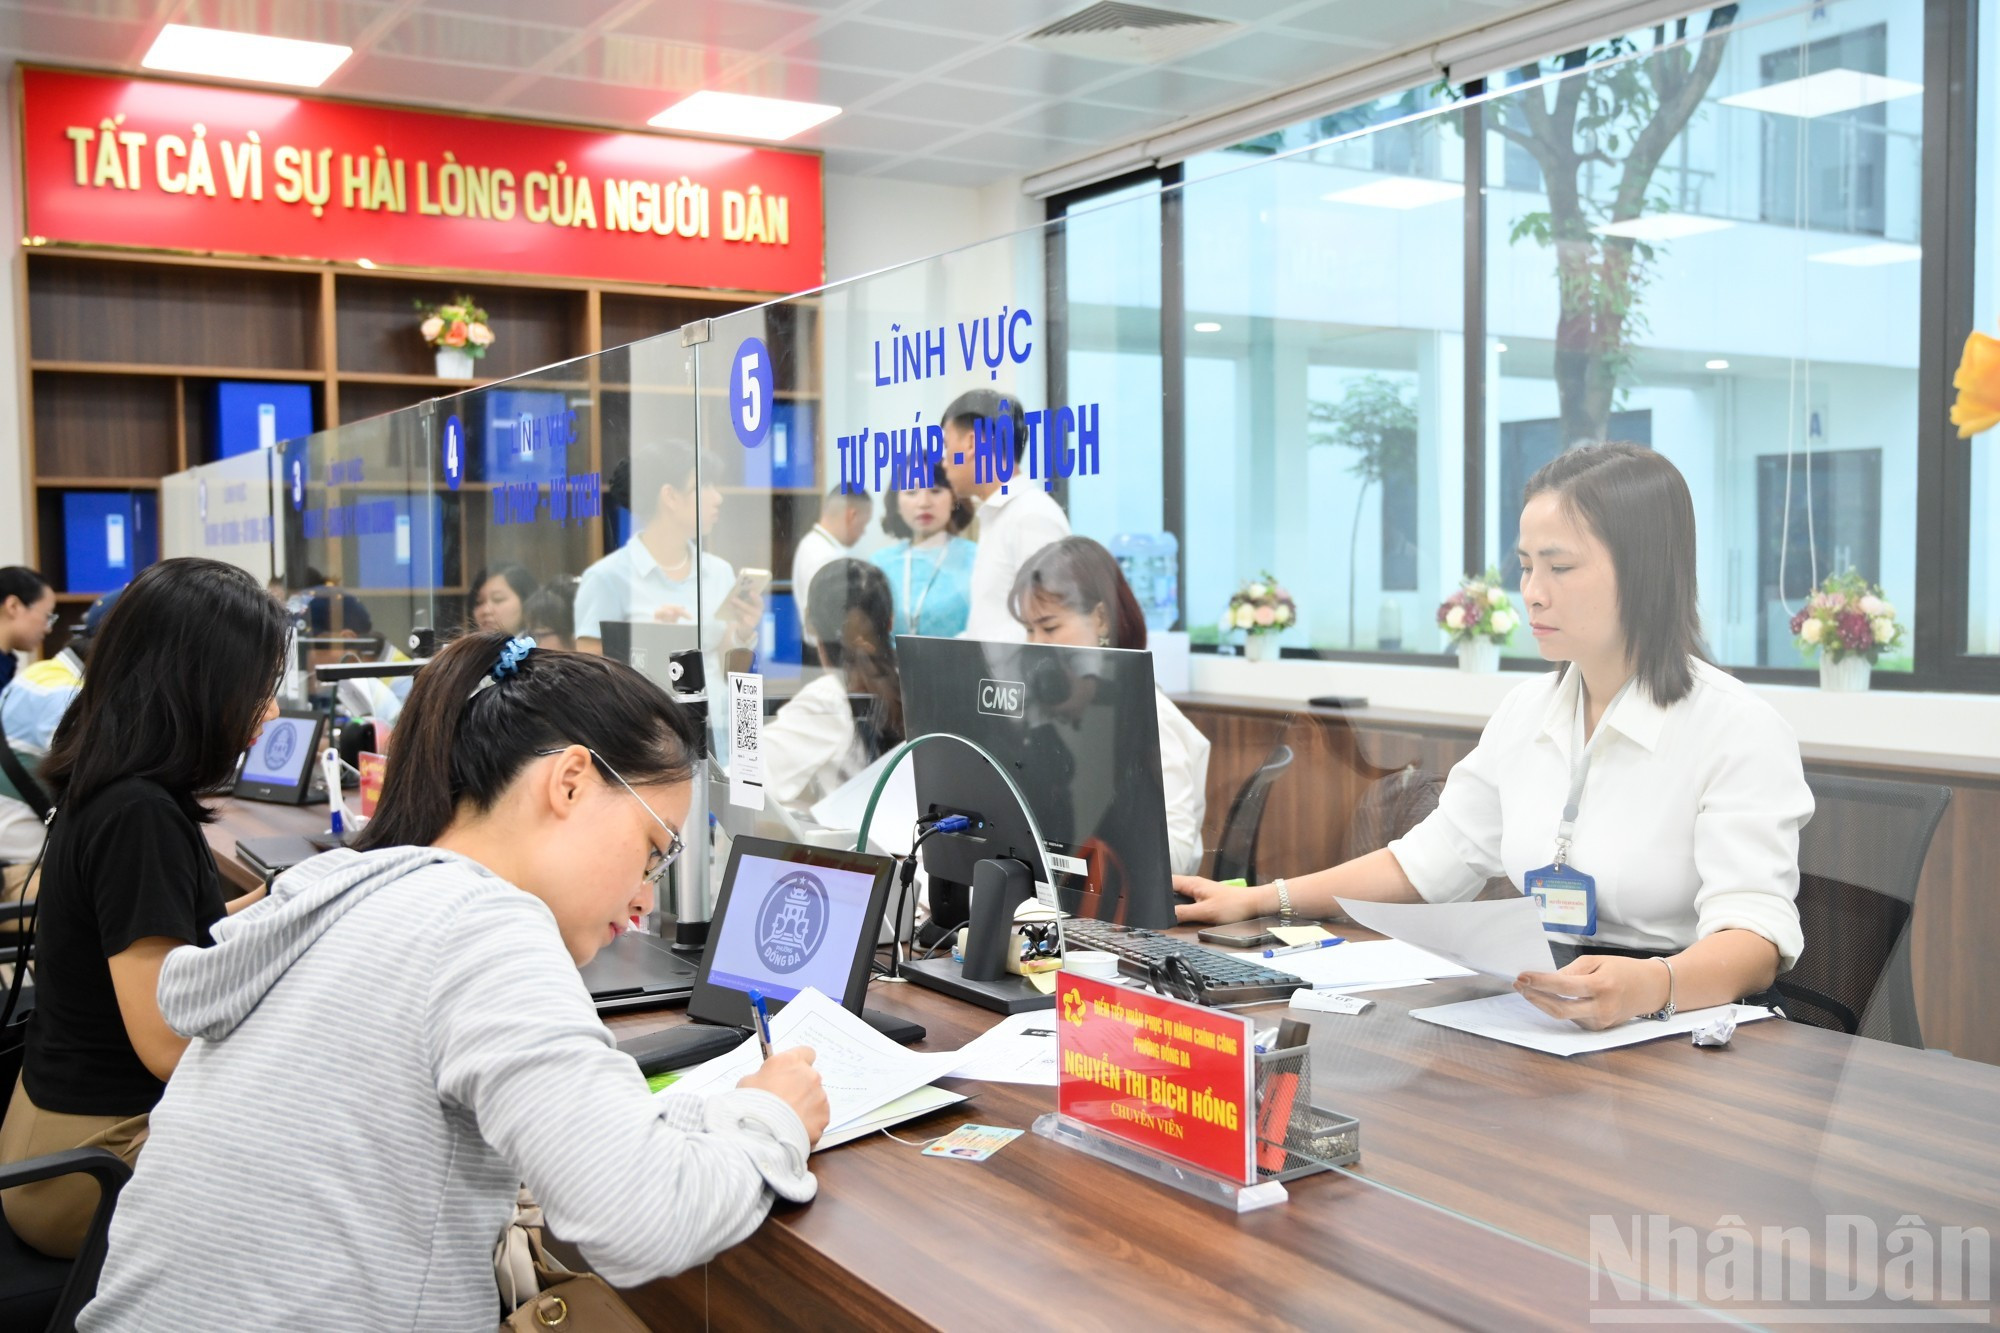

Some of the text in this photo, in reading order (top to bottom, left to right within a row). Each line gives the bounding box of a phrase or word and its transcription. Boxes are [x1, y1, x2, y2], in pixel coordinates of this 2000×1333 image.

[66, 113, 790, 245] TẤT CẢ VÌ SỰ HÀI LÒNG CỦA NGƯỜI DÂN
[874, 305, 1033, 388] LĨNH VỰC
[741, 352, 762, 432] 5
[293, 459, 302, 503] 3
[447, 425, 459, 478] 4
[837, 399, 1100, 496] TƯ PHÁP - HỘ TỊCH
[982, 685, 1018, 711] CMS
[1064, 1048, 1121, 1091] NGUYỄN
[1124, 1068, 1147, 1105] THỊ
[1151, 1075, 1187, 1114] BÍCH
[1192, 1086, 1238, 1131] HỒNG
[1111, 1102, 1184, 1140] CHUYÊN VIÊN
